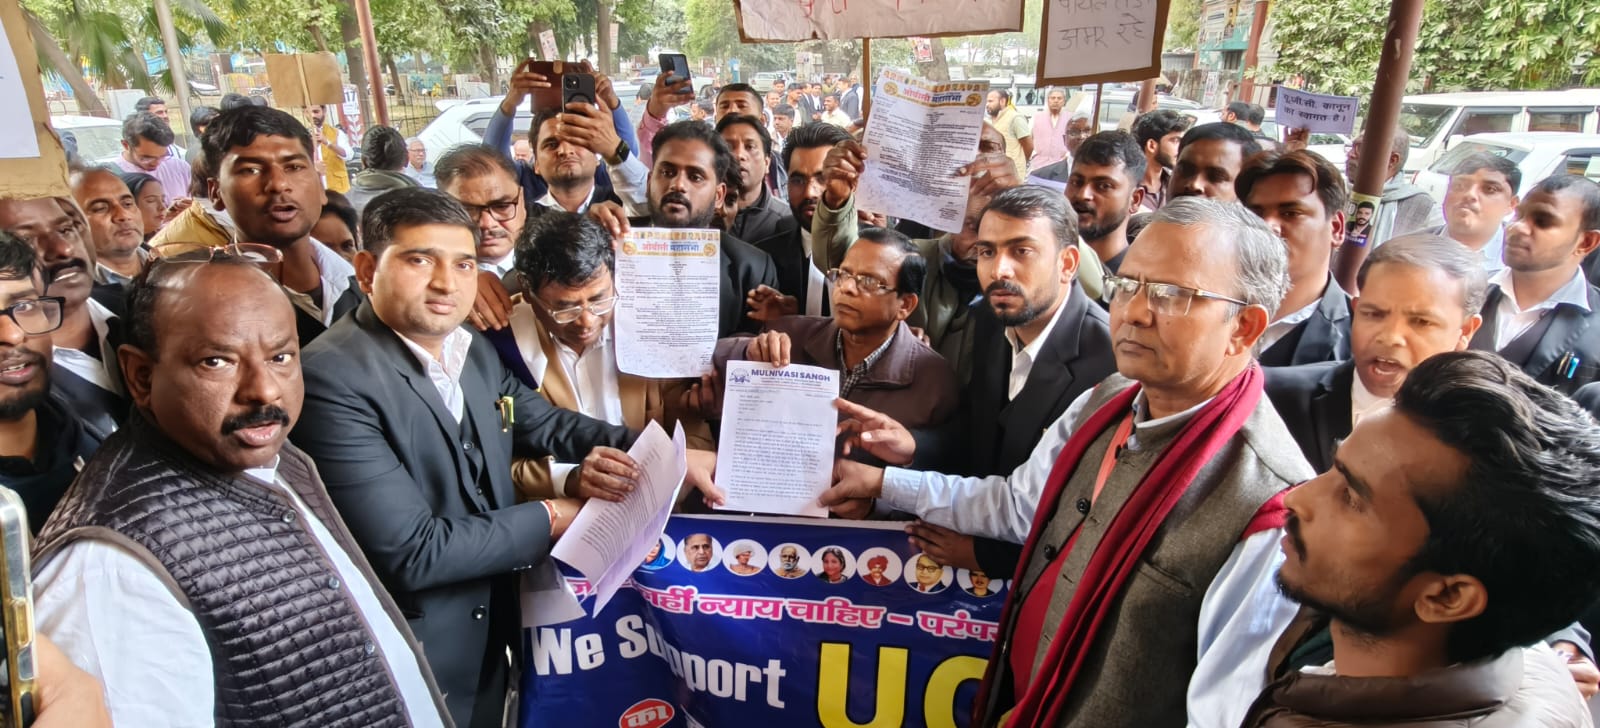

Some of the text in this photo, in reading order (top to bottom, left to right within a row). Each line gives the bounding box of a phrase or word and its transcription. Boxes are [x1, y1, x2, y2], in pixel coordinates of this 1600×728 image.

[1058, 12, 1145, 50] अमर रहे
[1284, 106, 1295, 115] का
[1298, 111, 1327, 121] स्वागत
[1322, 102, 1351, 112] कानून
[751, 369, 831, 382] MULNIVASI SANGH
[698, 594, 785, 621] न्याय
[785, 597, 887, 628] चाहिए
[531, 627, 605, 676] We
[616, 614, 786, 709] Support
[625, 704, 670, 727] का
